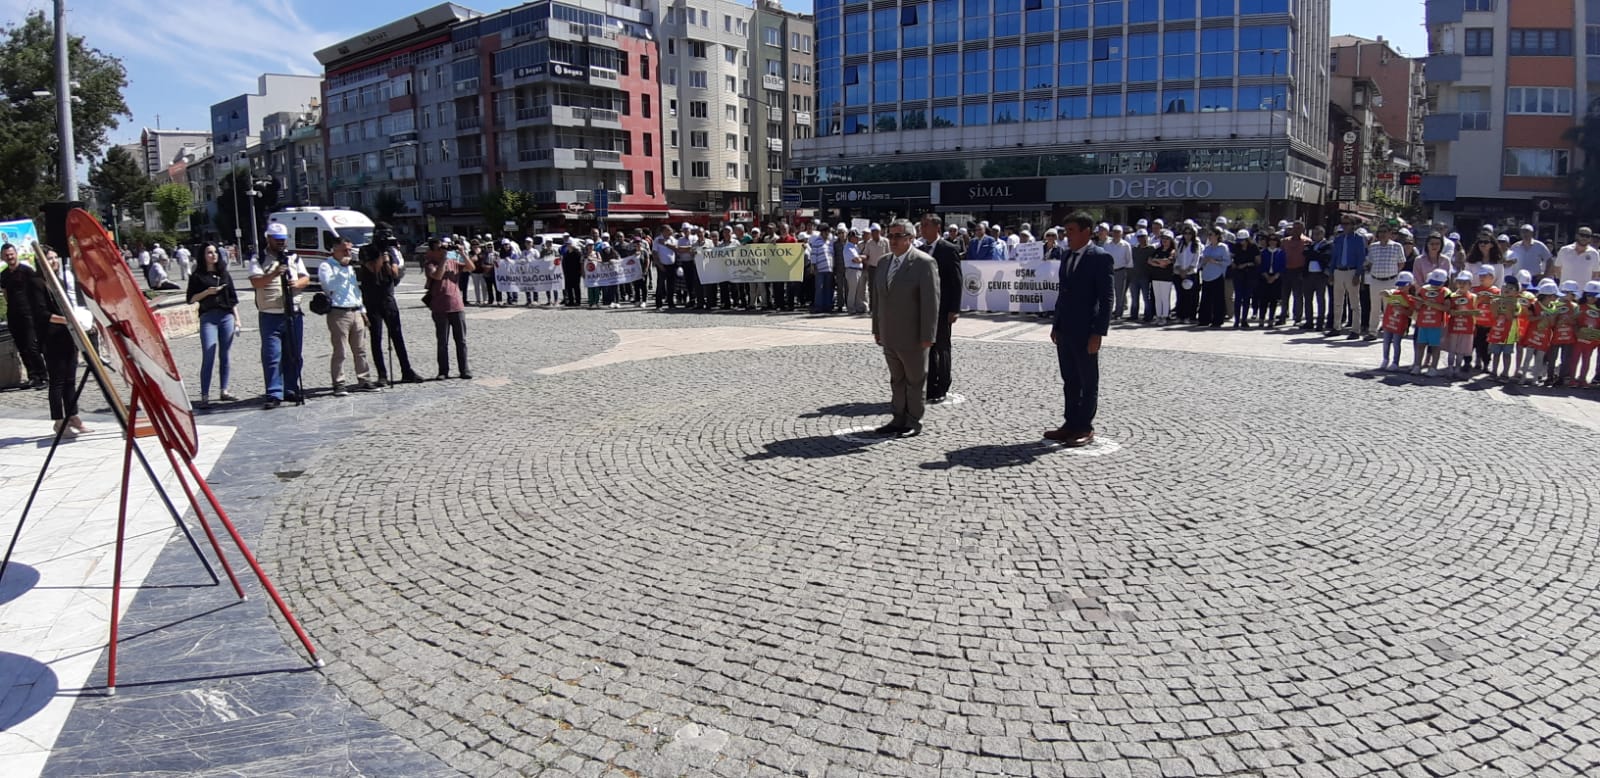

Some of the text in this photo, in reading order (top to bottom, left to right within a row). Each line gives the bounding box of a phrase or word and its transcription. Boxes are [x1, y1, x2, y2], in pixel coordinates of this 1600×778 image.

[969, 183, 1013, 199] ŞİMAL
[1108, 176, 1213, 198] DeFacto
[703, 246, 794, 258] MURAT DAĞI YOK
[522, 272, 563, 283] DAĞCILIK
[1015, 268, 1036, 279] UŞAK
[987, 281, 1012, 292] ÇEVRE
[1010, 293, 1043, 304] DERNEĞİ
